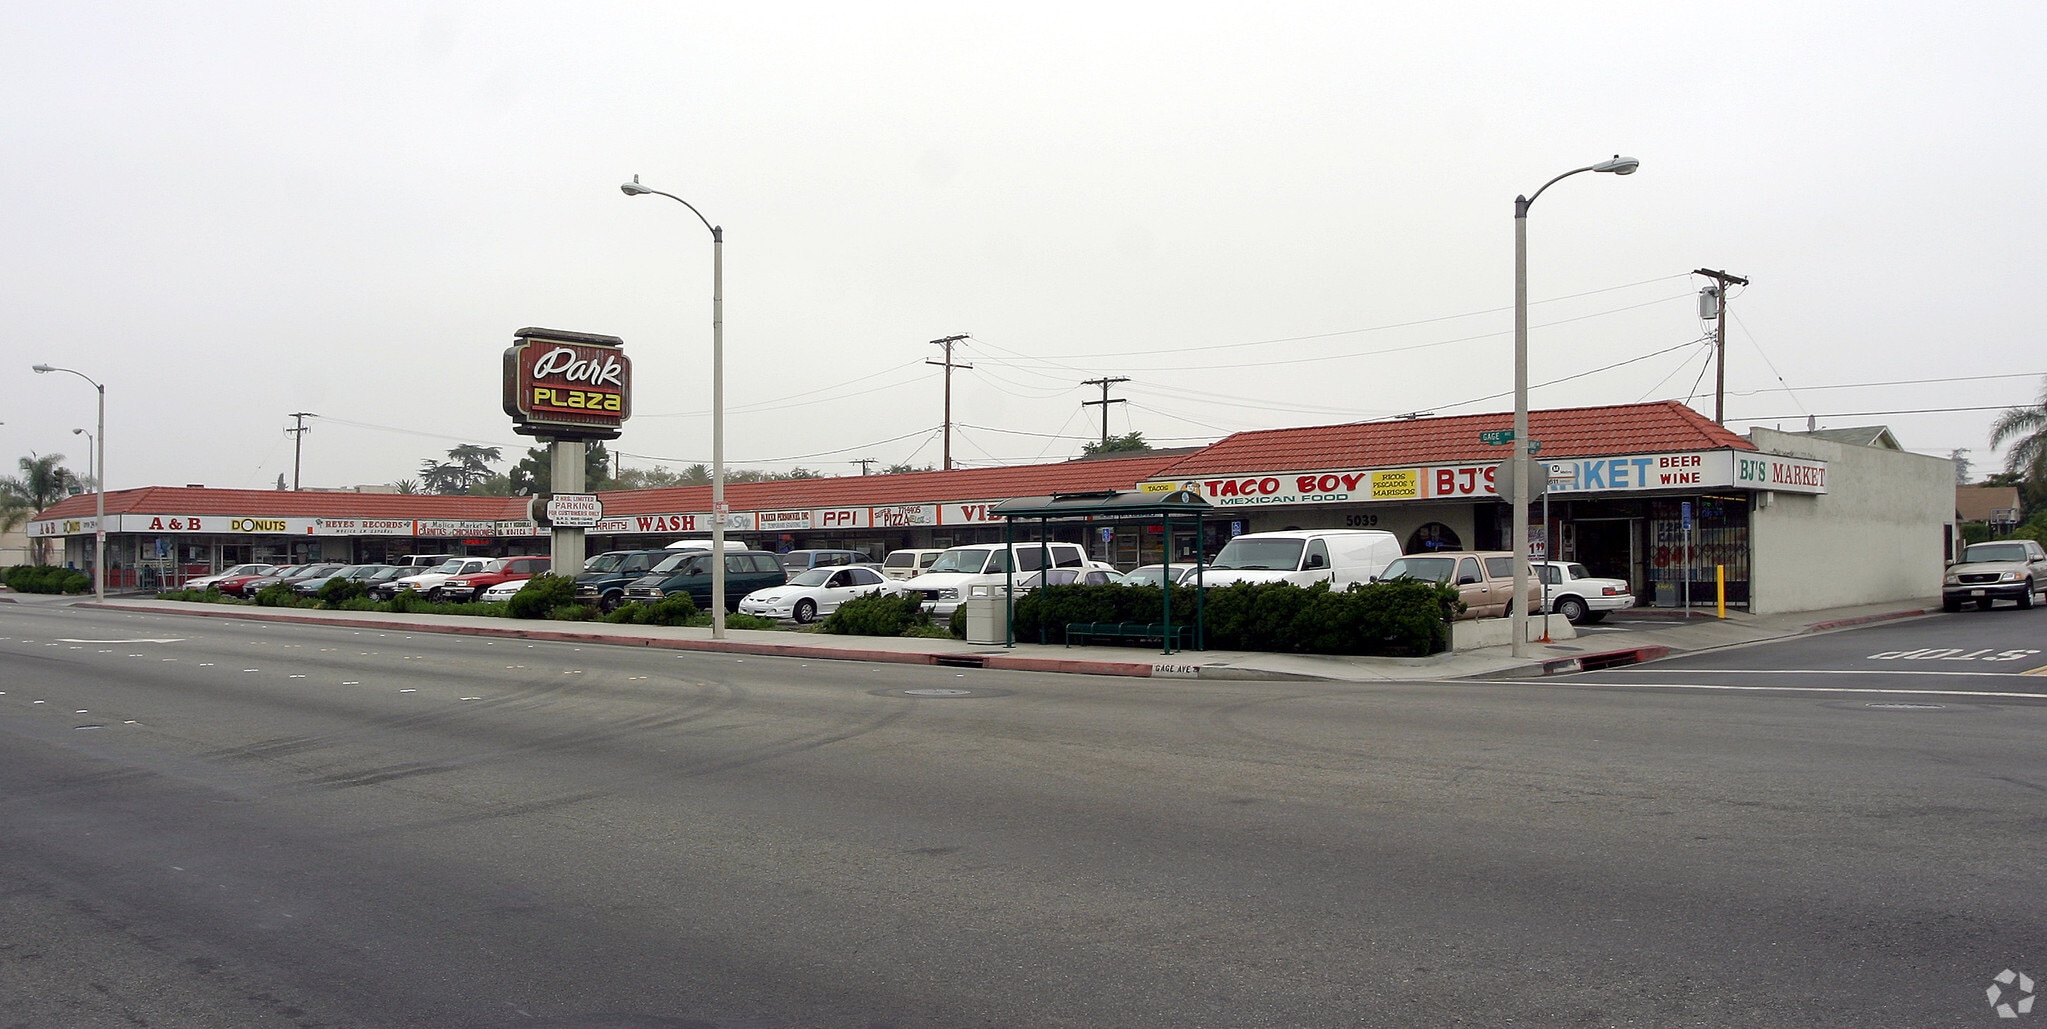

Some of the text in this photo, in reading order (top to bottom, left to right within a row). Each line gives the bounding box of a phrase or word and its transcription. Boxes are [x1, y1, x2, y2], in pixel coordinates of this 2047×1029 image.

[533, 346, 622, 386] Park
[1482, 432, 1500, 441] GAGE
[1659, 455, 1702, 468] BEER
[1381, 473, 1406, 481] RICOS
[1659, 472, 1701, 485] WINE
[1739, 459, 1826, 487] BJ'S MARKET
[1204, 473, 1366, 497] TACO BOY
[1373, 480, 1408, 489] PESCADOS
[1436, 466, 1498, 495] BJ'S
[1147, 484, 1169, 492] TACOS
[1373, 488, 1416, 497] MARISCOS
[1220, 493, 1349, 505] MEXICAN FOOD
[555, 502, 595, 510] PARKING
[149, 517, 201, 530] A & B
[636, 515, 696, 532] WASH
[823, 510, 857, 526] PPI
[884, 513, 910, 527] PIZZA
[1346, 515, 1378, 527] 5039
[232, 518, 286, 532] DONUTS
[362, 521, 403, 529] RECORDS
[419, 528, 447, 536] CARNITAS
[1866, 648, 2042, 662] STOP
[1155, 664, 1174, 672] GAGE
[1177, 665, 1191, 673] AVE
